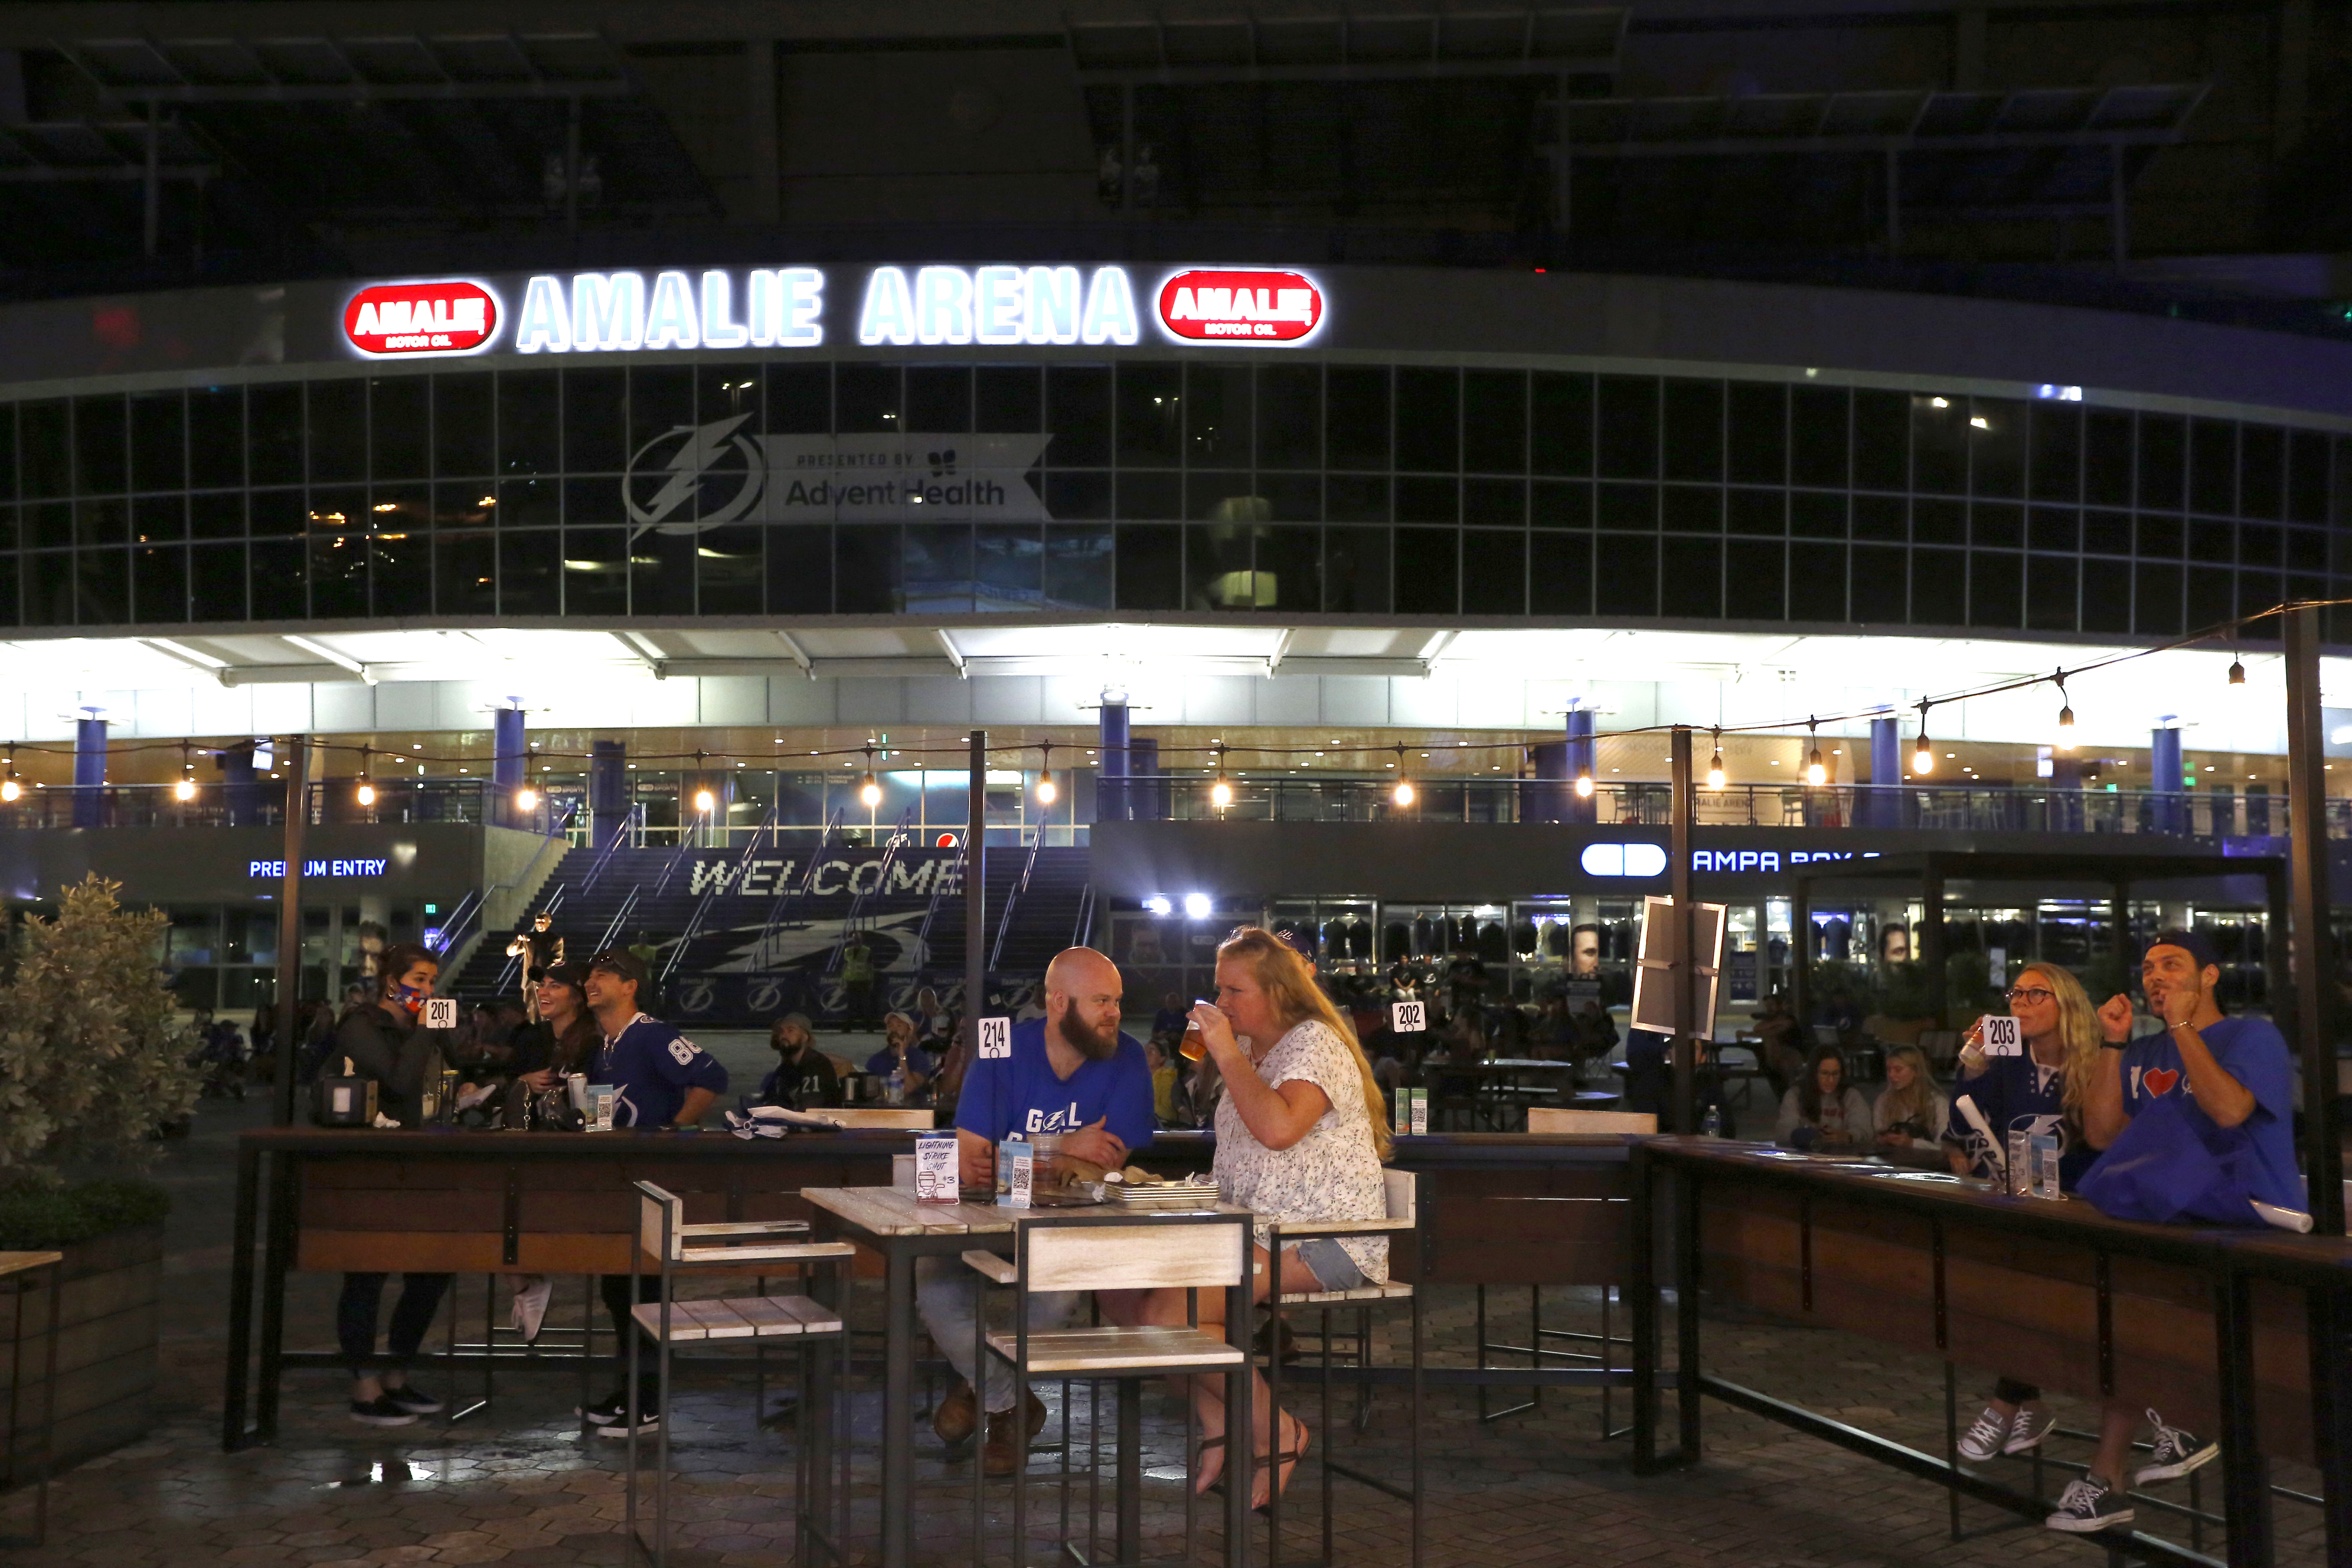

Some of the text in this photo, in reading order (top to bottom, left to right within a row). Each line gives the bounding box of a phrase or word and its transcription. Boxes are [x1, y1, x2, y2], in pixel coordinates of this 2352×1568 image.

[515, 267, 1138, 348] AMALIE ARENA
[1170, 287, 1312, 323] AMALIE
[354, 298, 485, 335] AMALIE
[1205, 323, 1252, 335] MOTOR
[385, 335, 429, 348] MOTOR
[797, 453, 913, 466] PRESENTED BY
[332, 859, 386, 876] ENTRY
[1672, 851, 1780, 872] AMPA
[690, 860, 969, 895] WELCOME
[431, 1002, 449, 1019] 201
[1399, 1005, 1420, 1024] 202
[984, 1021, 1005, 1047] 214
[1990, 1020, 2015, 1044] 203
[802, 1075, 820, 1094] 21
[918, 1141, 954, 1149] LIGHTNING
[923, 1152, 950, 1160] STRIKE
[927, 1162, 947, 1171] SHOT
